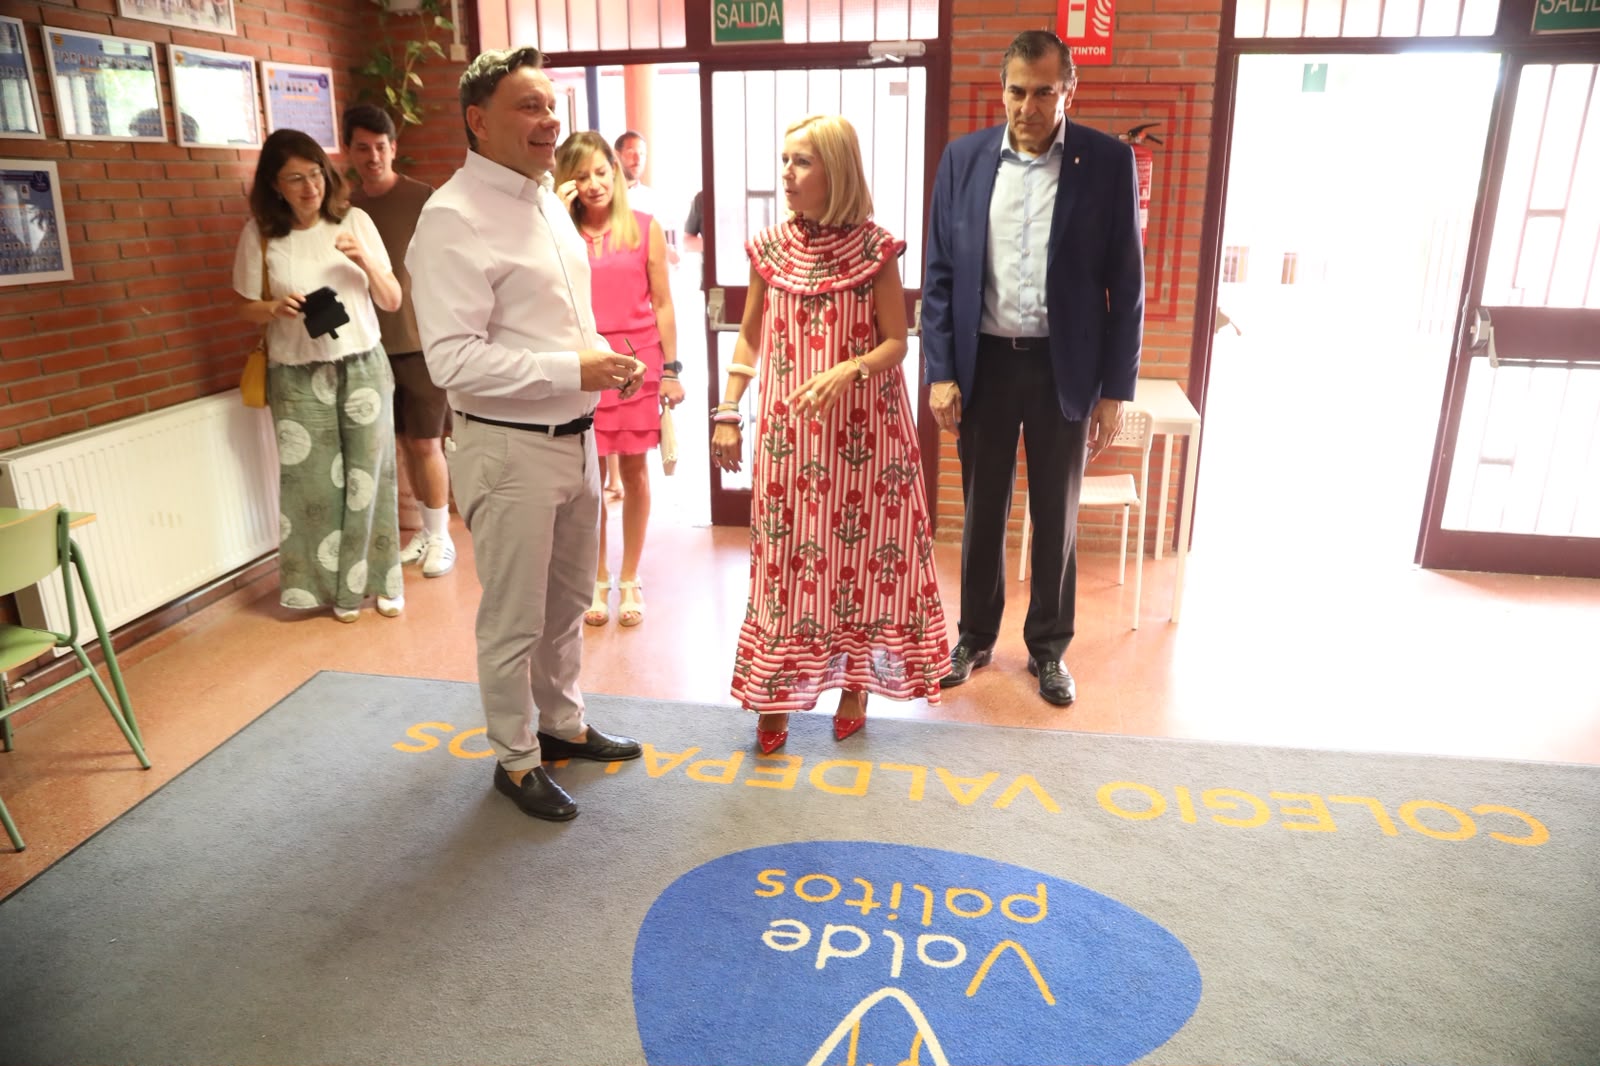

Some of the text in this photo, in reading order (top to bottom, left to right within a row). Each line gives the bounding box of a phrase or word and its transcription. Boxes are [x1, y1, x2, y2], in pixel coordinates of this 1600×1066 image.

[717, 2, 780, 29] SALIDA
[1070, 46, 1106, 56] TINTOR
[393, 721, 1550, 846] COLEGIO VALDEPAOS
[753, 868, 1049, 927] palitos
[761, 918, 1057, 1006] Valde
